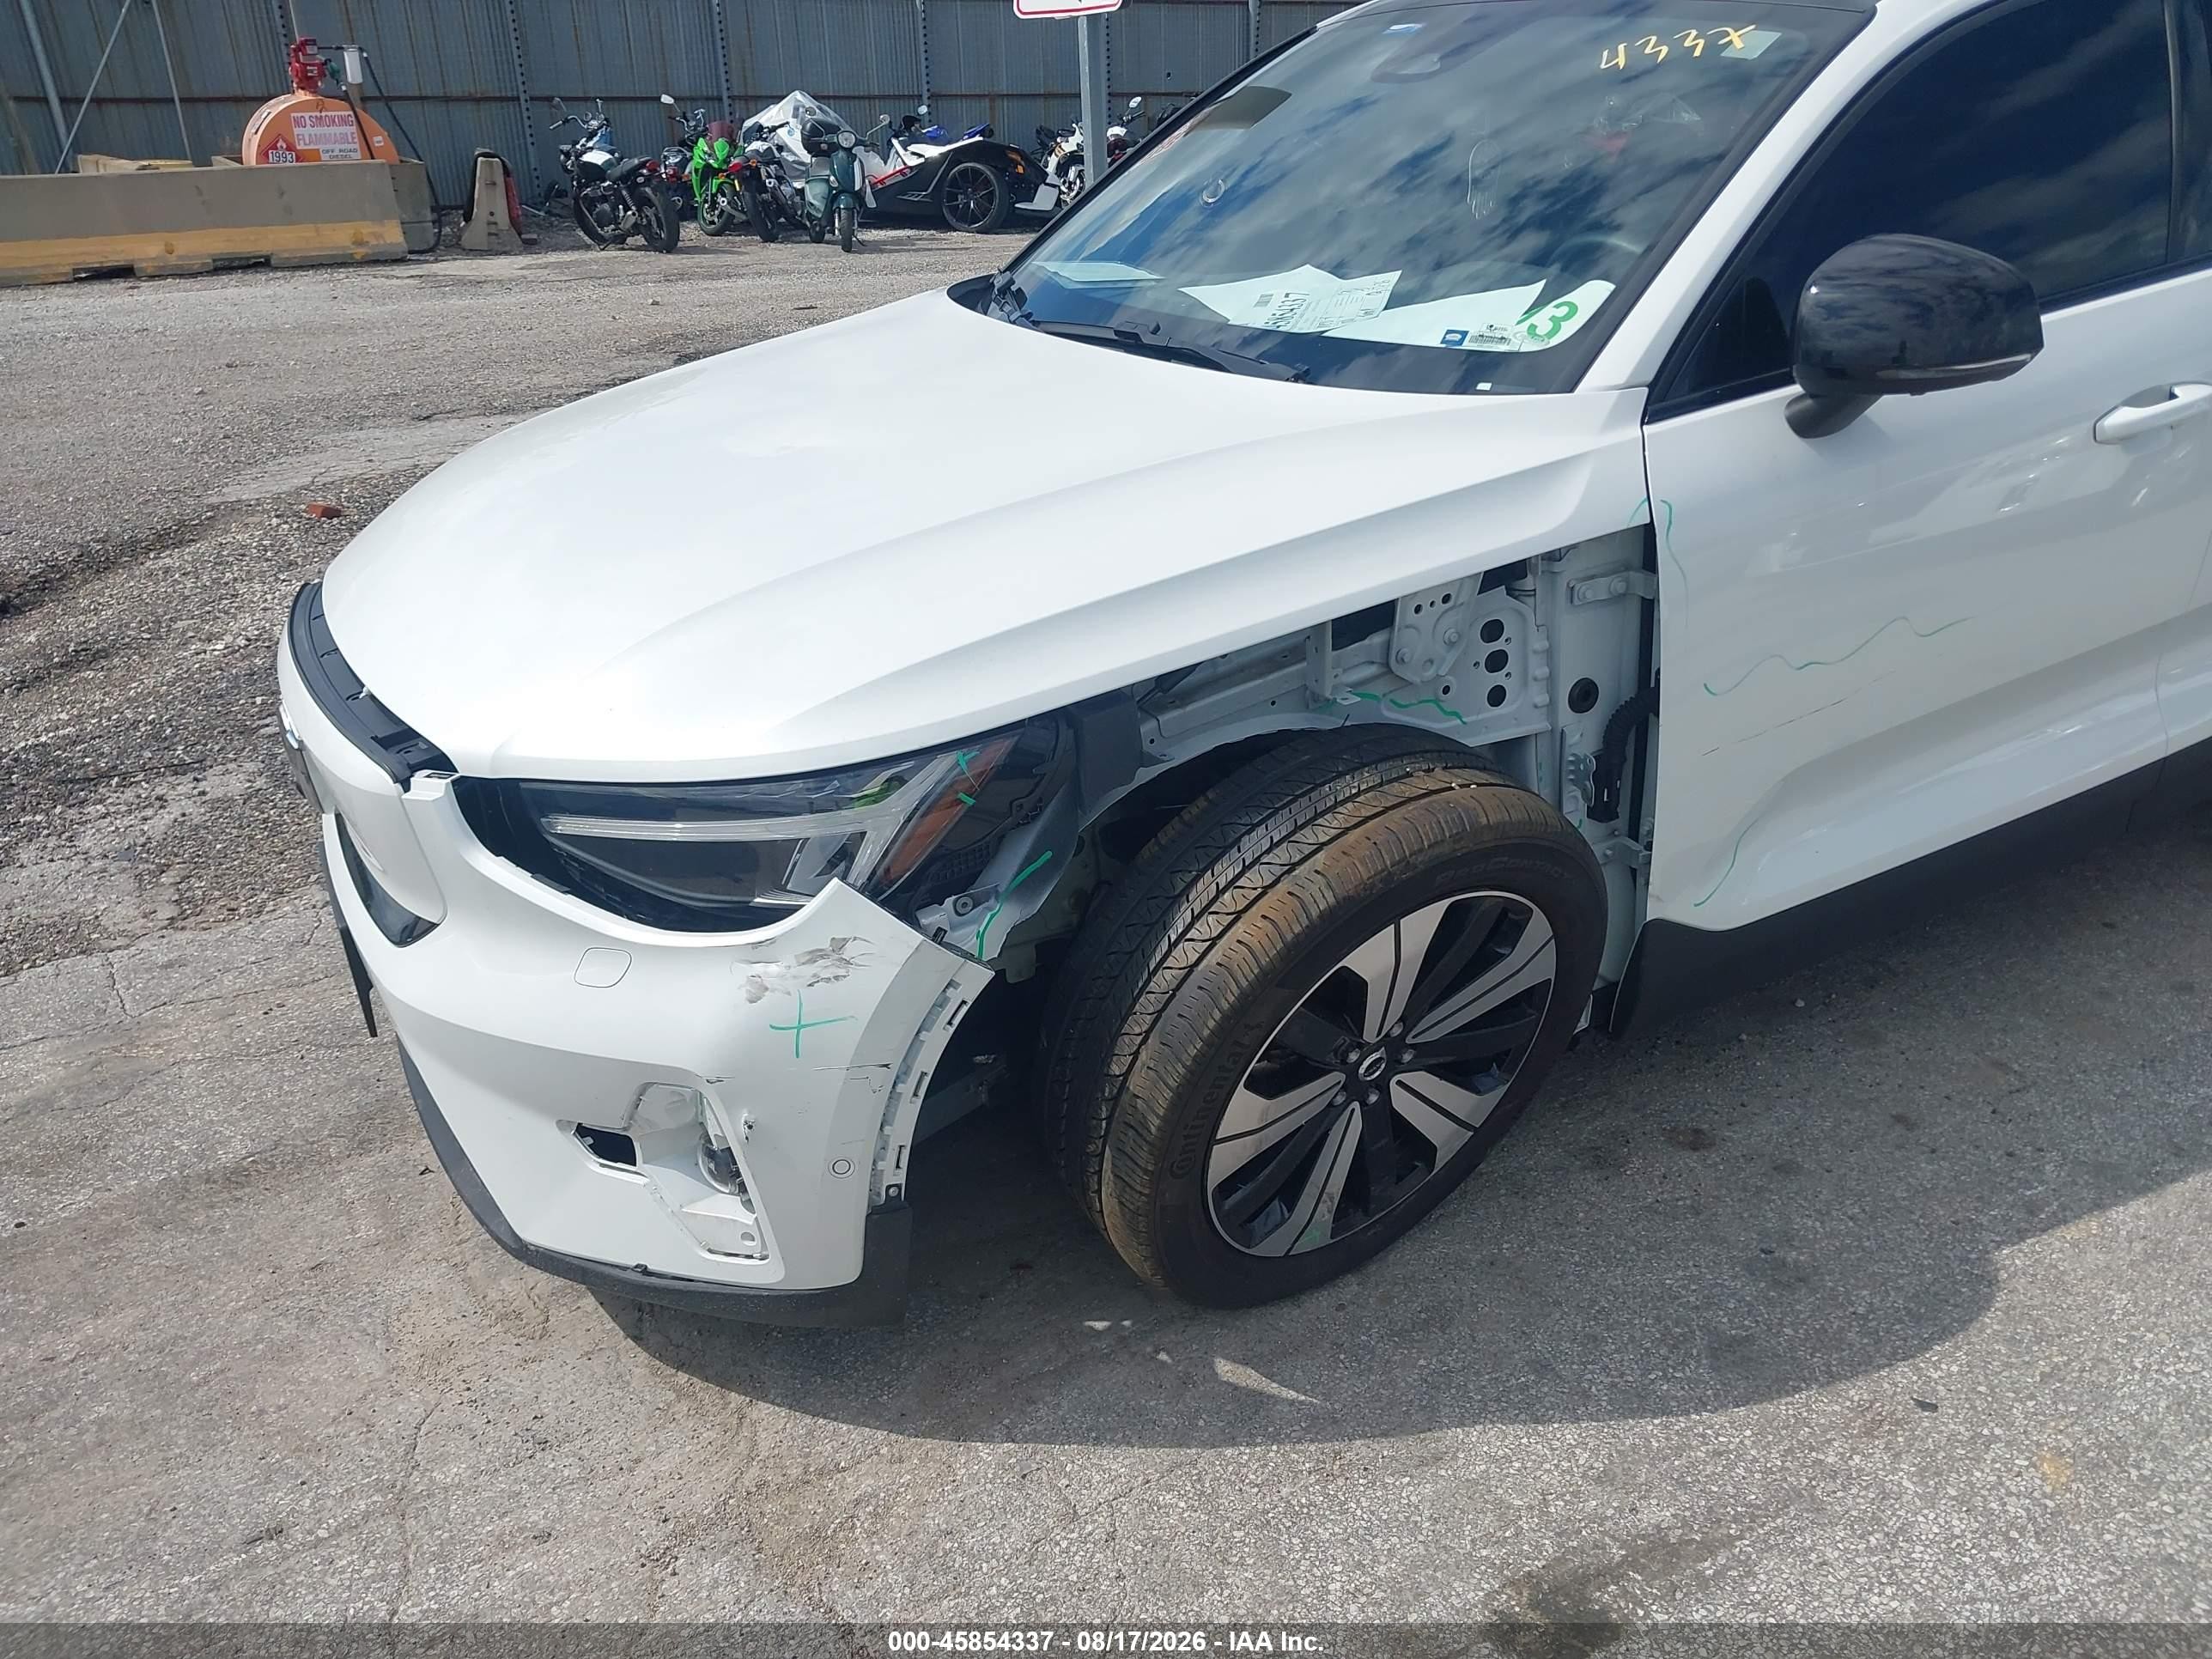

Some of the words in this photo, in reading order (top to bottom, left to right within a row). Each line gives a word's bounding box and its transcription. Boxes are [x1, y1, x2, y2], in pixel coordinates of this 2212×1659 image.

[293, 115, 307, 128] NO
[309, 113, 354, 128] SMOKING
[296, 131, 358, 146] FLAMMABLE
[270, 151, 295, 164] 1993
